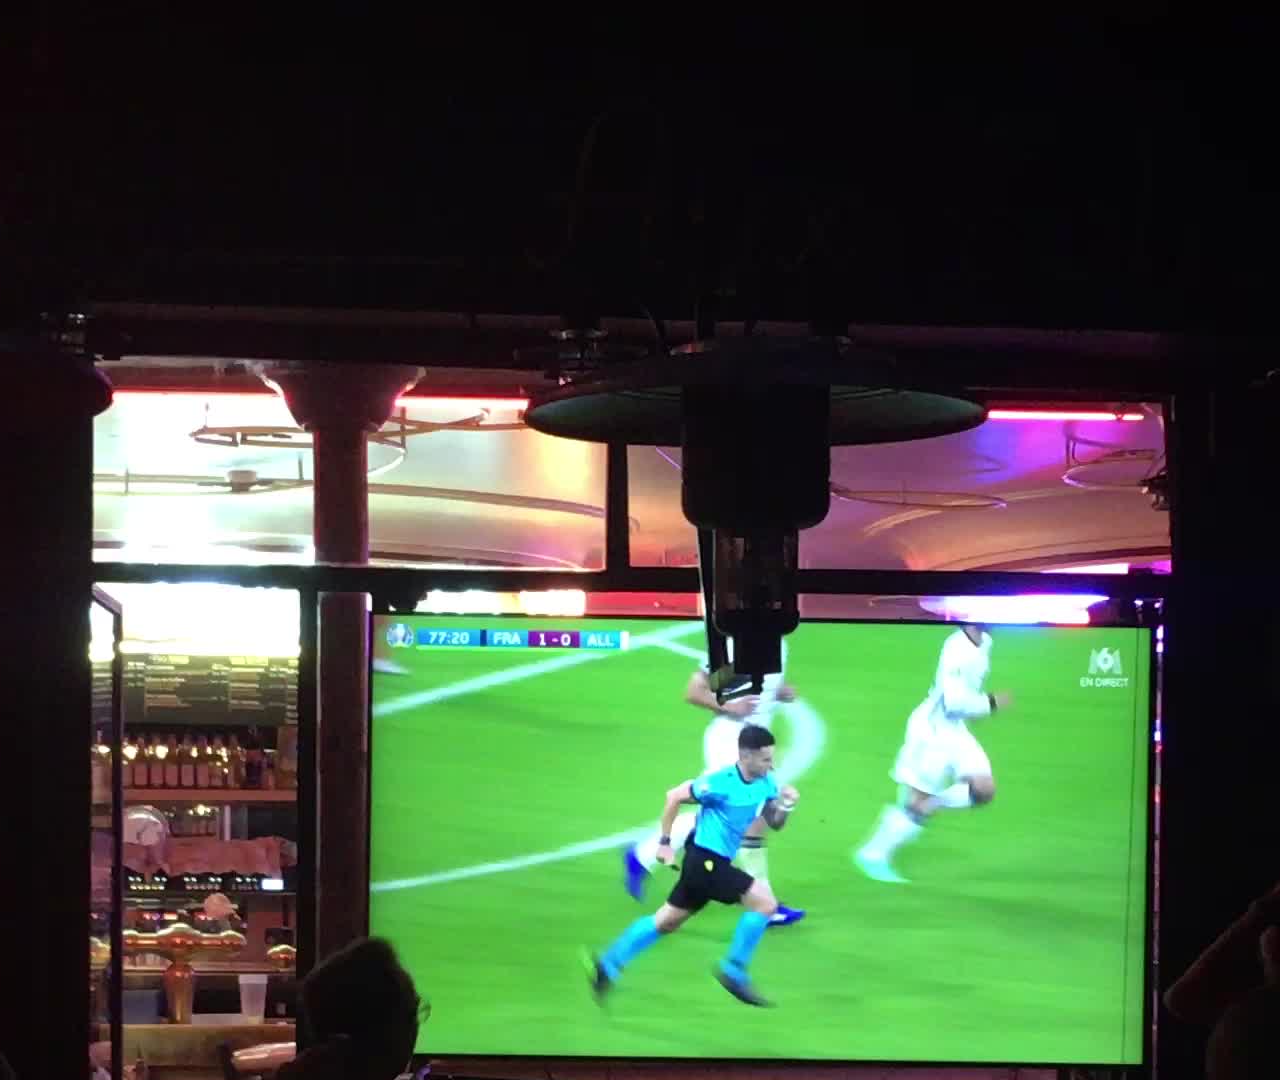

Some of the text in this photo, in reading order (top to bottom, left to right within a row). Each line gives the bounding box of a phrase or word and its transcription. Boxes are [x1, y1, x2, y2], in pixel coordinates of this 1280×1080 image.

[428, 631, 470, 645] 77:20
[493, 631, 521, 645] FRA
[587, 633, 614, 647] ALL
[1080, 677, 1129, 688] EN DIRECT
